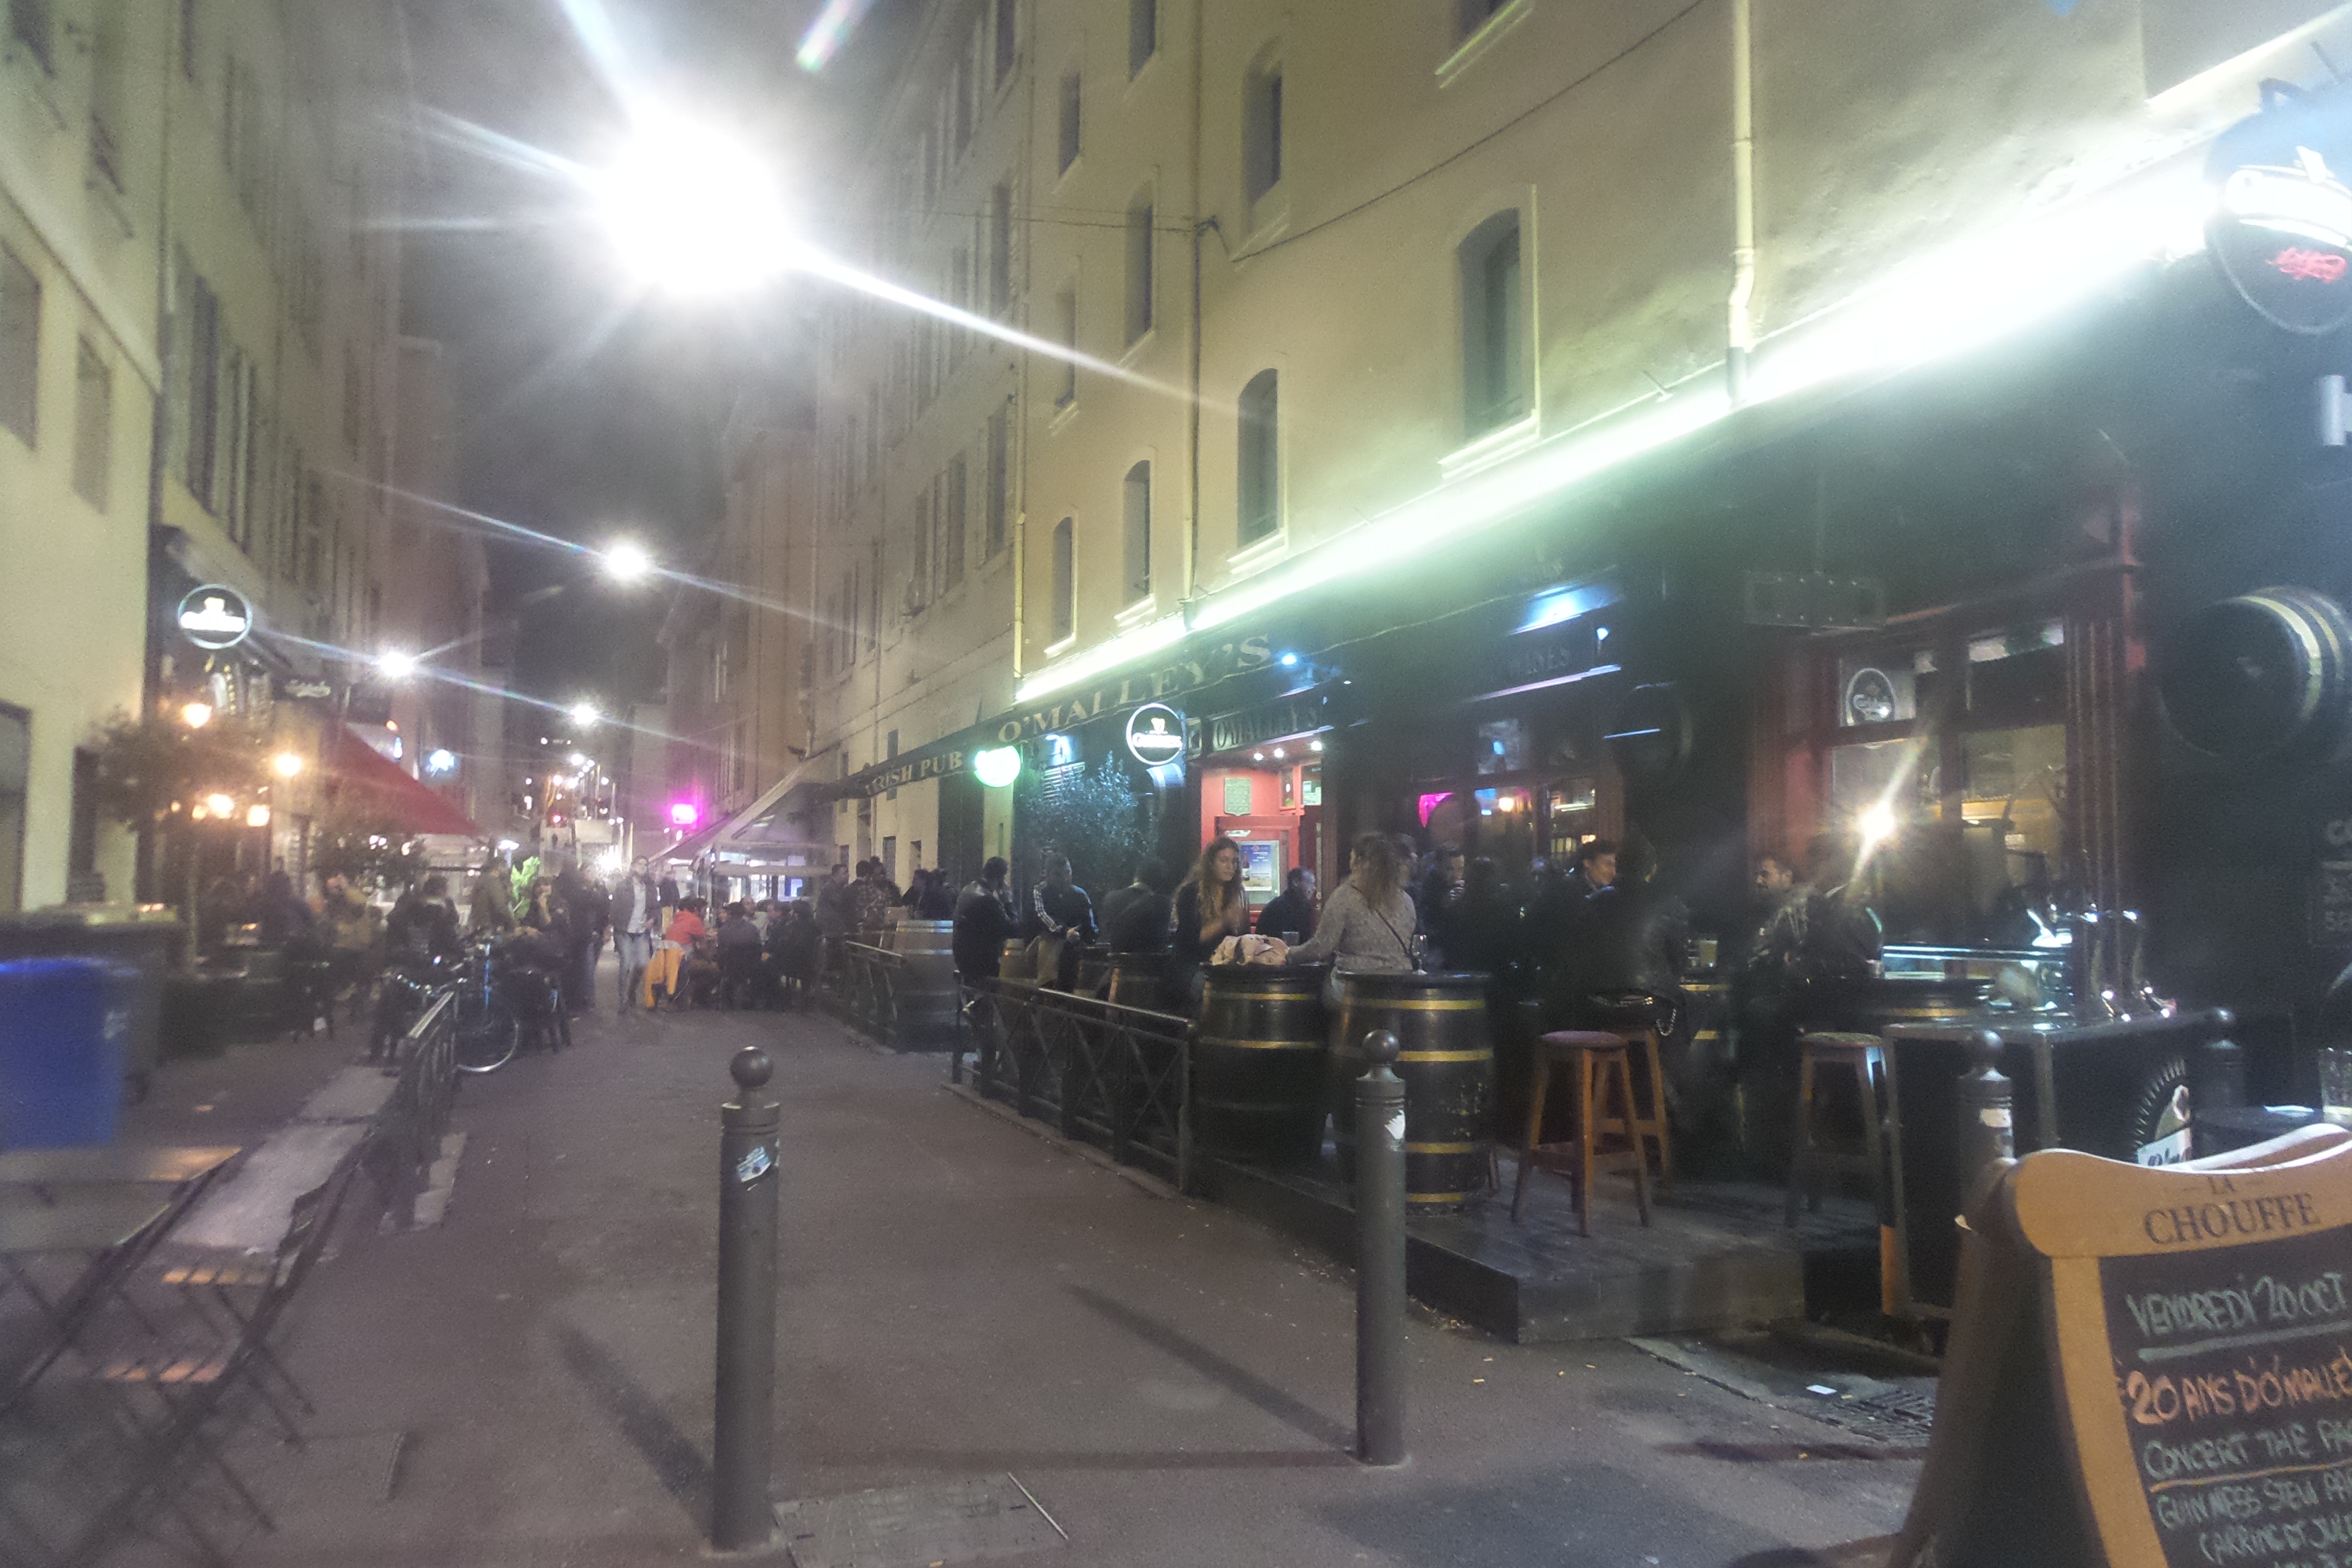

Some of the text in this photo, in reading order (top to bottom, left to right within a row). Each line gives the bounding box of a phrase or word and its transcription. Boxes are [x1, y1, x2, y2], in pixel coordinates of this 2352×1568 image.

[865, 751, 963, 795] IRISH PUB
[2144, 1192, 2321, 1244] CHOUFFE
[2126, 1370, 2180, 1424] 20
[2182, 1373, 2236, 1421] ANS
[2144, 1431, 2249, 1480] CONCERT
[2255, 1422, 2312, 1459] THE
